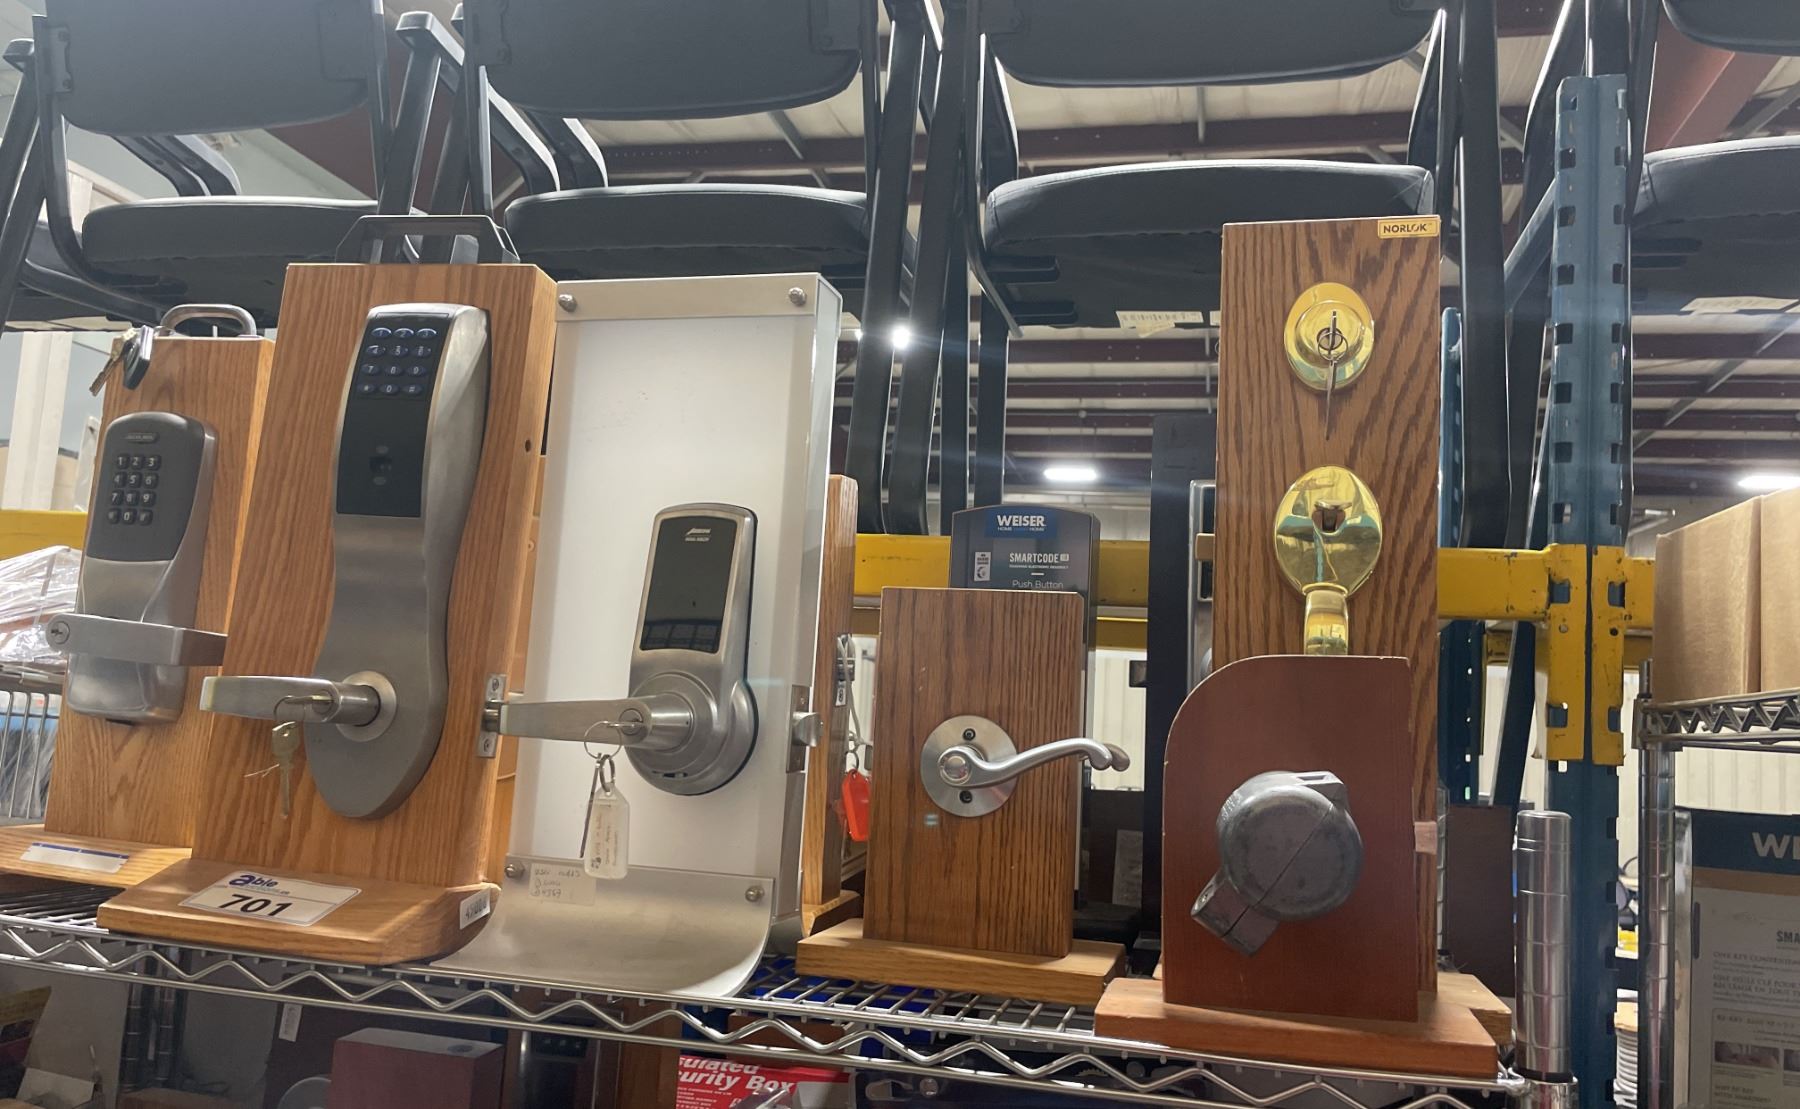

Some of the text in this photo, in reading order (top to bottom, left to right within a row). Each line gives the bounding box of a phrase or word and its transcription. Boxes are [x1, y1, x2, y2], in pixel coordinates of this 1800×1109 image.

[1383, 223, 1427, 234] NORLOK
[996, 514, 1047, 527] WEISER
[1009, 552, 1059, 564] SMARTCODE
[1012, 580, 1064, 590] Push Button
[218, 893, 293, 917] 701
